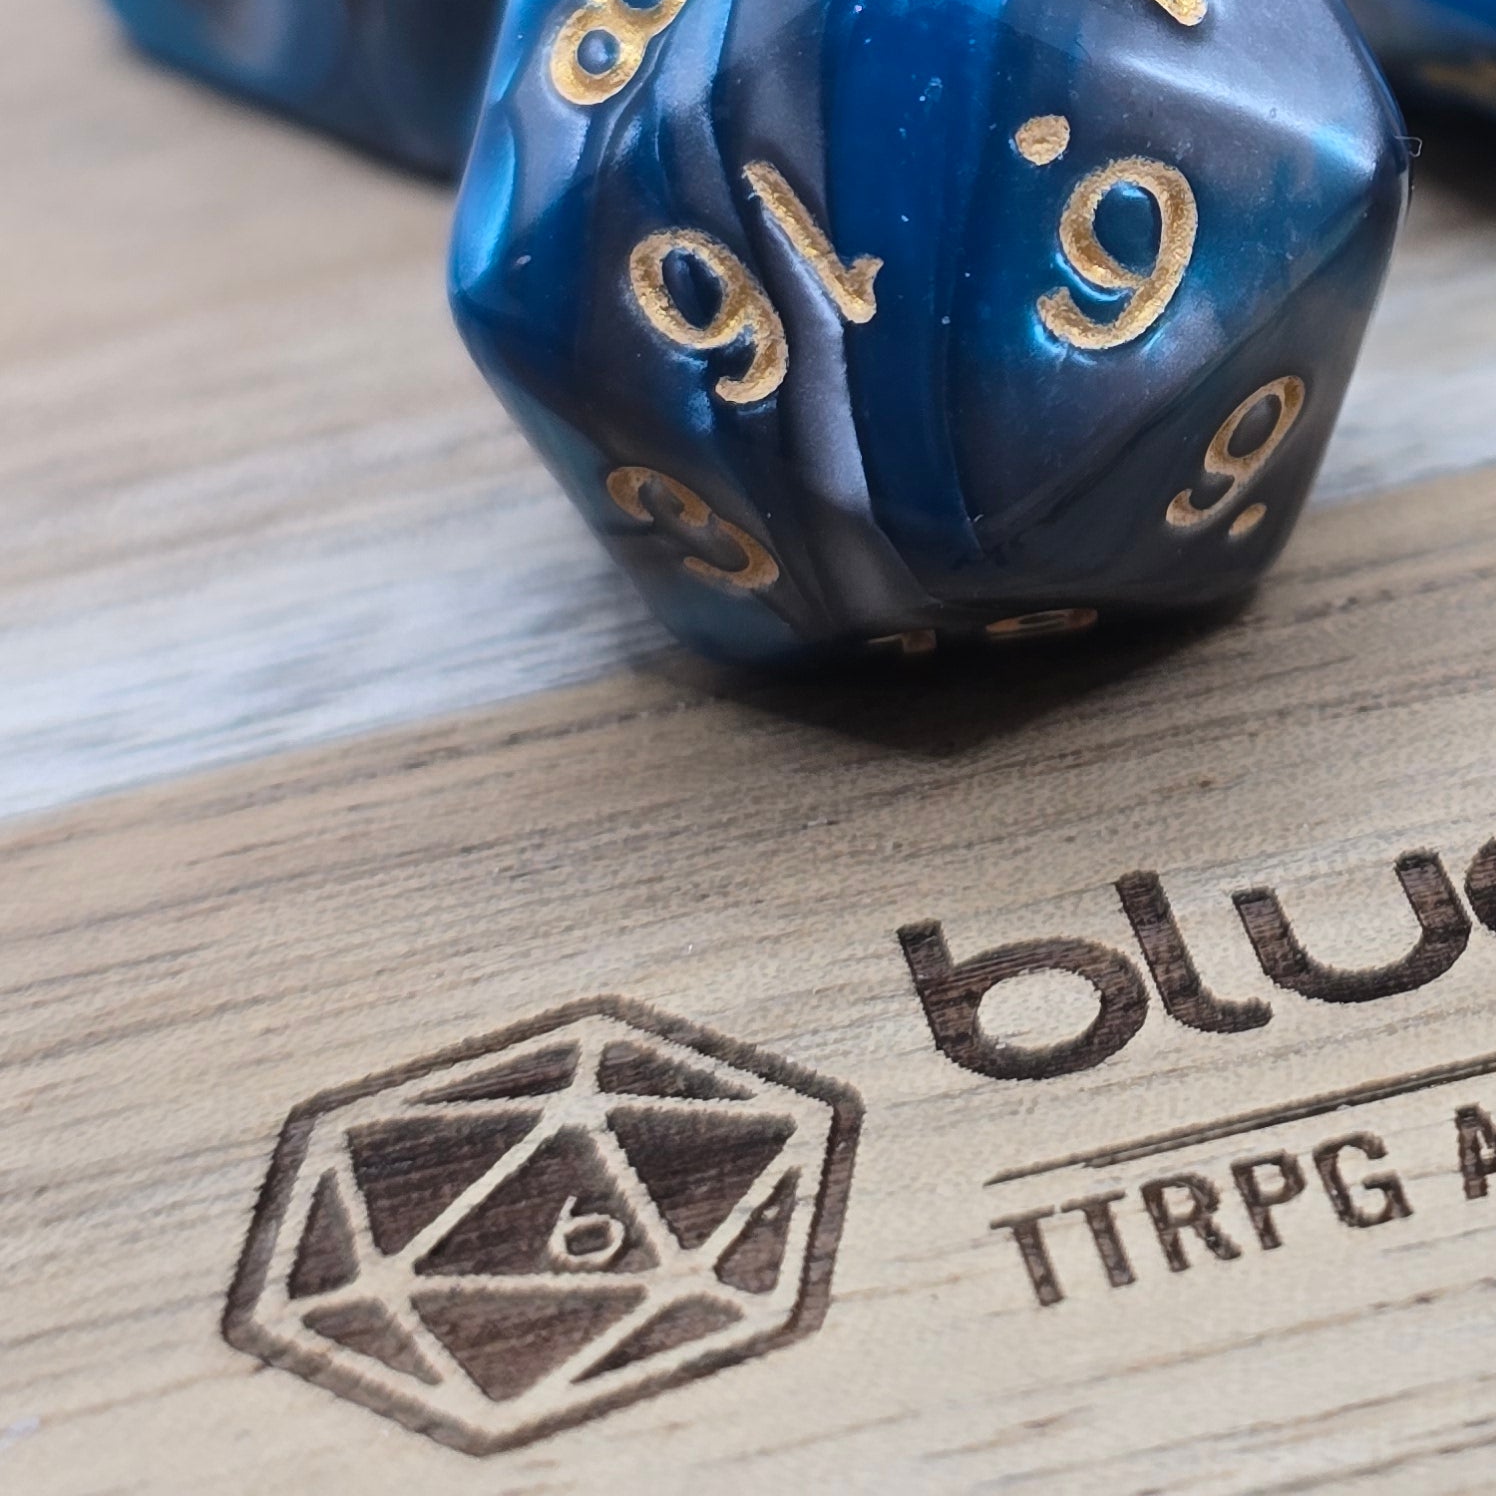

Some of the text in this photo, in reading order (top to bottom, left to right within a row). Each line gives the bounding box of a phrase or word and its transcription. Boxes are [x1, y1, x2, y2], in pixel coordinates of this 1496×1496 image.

[629, 160, 884, 404] 16
[605, 465, 780, 592] 3
[546, 1195, 626, 1266] 6
[988, 1130, 1415, 1307] TTRPG
